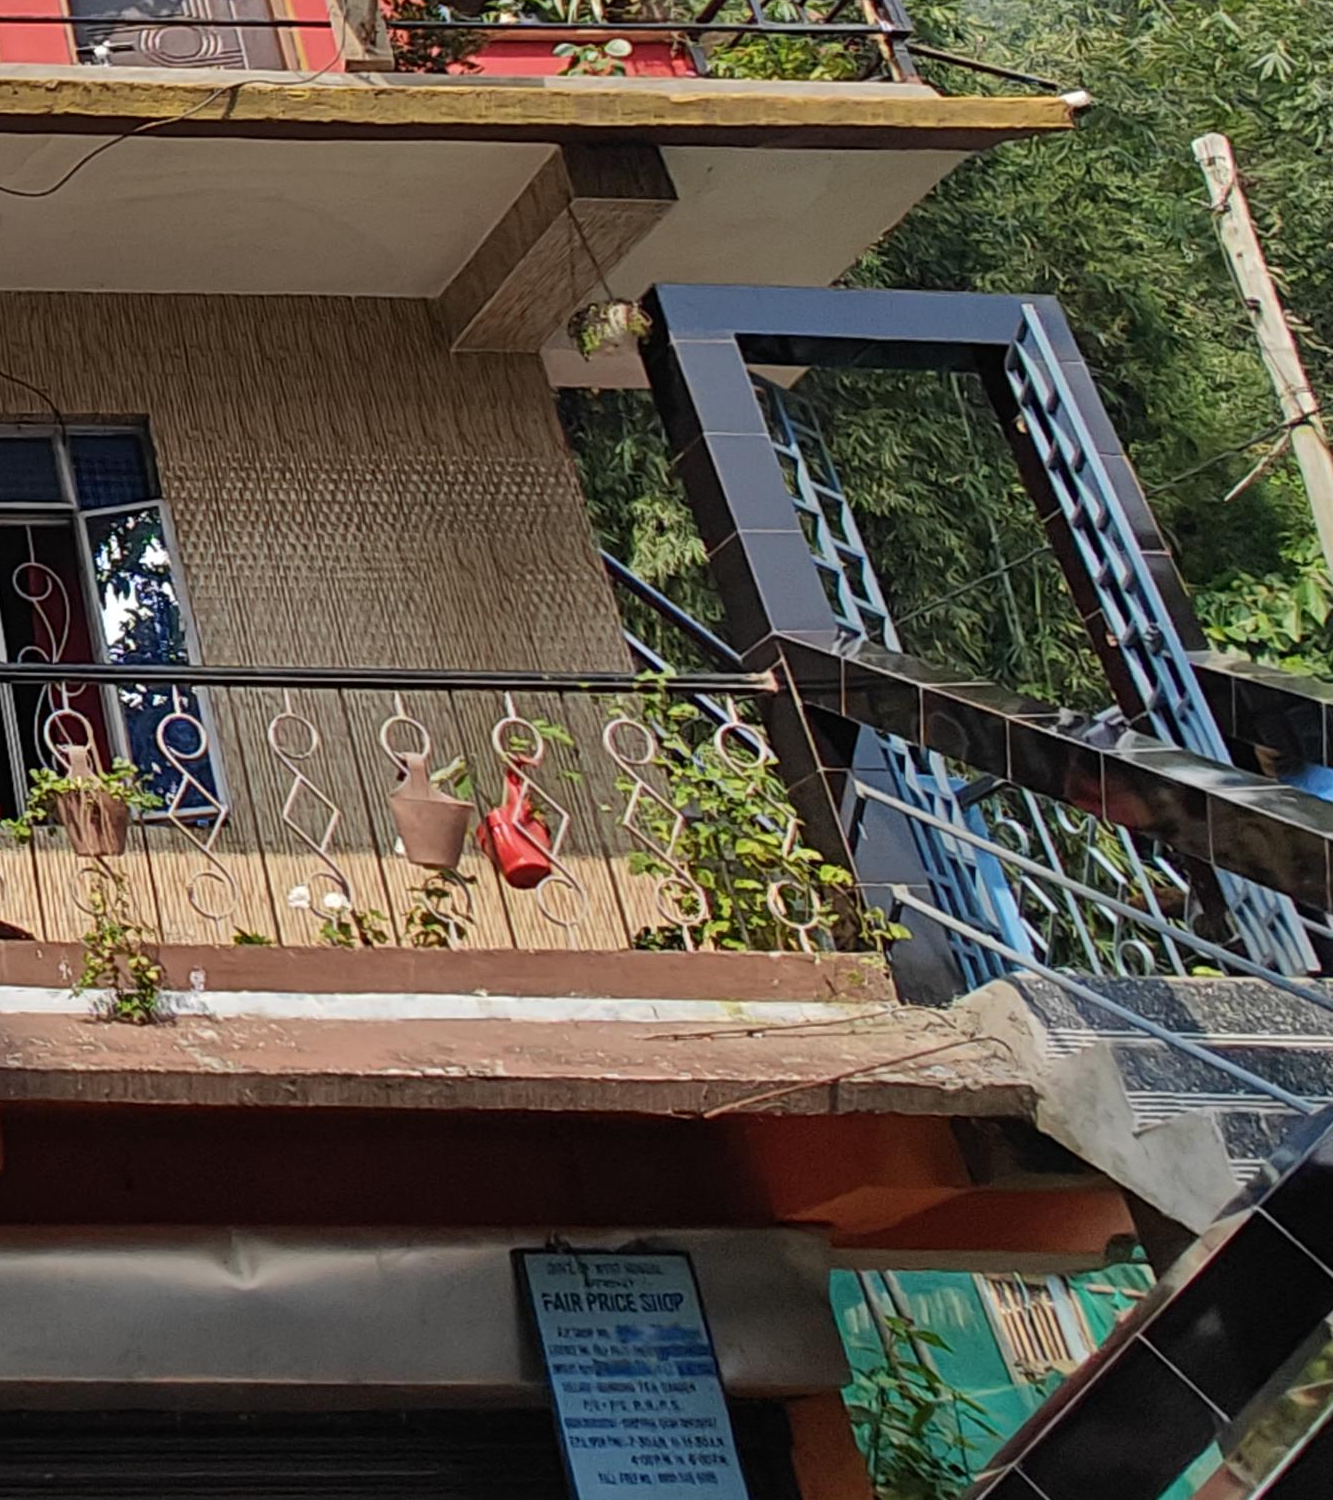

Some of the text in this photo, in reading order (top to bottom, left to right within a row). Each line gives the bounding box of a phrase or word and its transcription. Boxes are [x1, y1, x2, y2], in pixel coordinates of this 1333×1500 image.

[541, 1292, 684, 1313] FAIR PRICE SHOP
